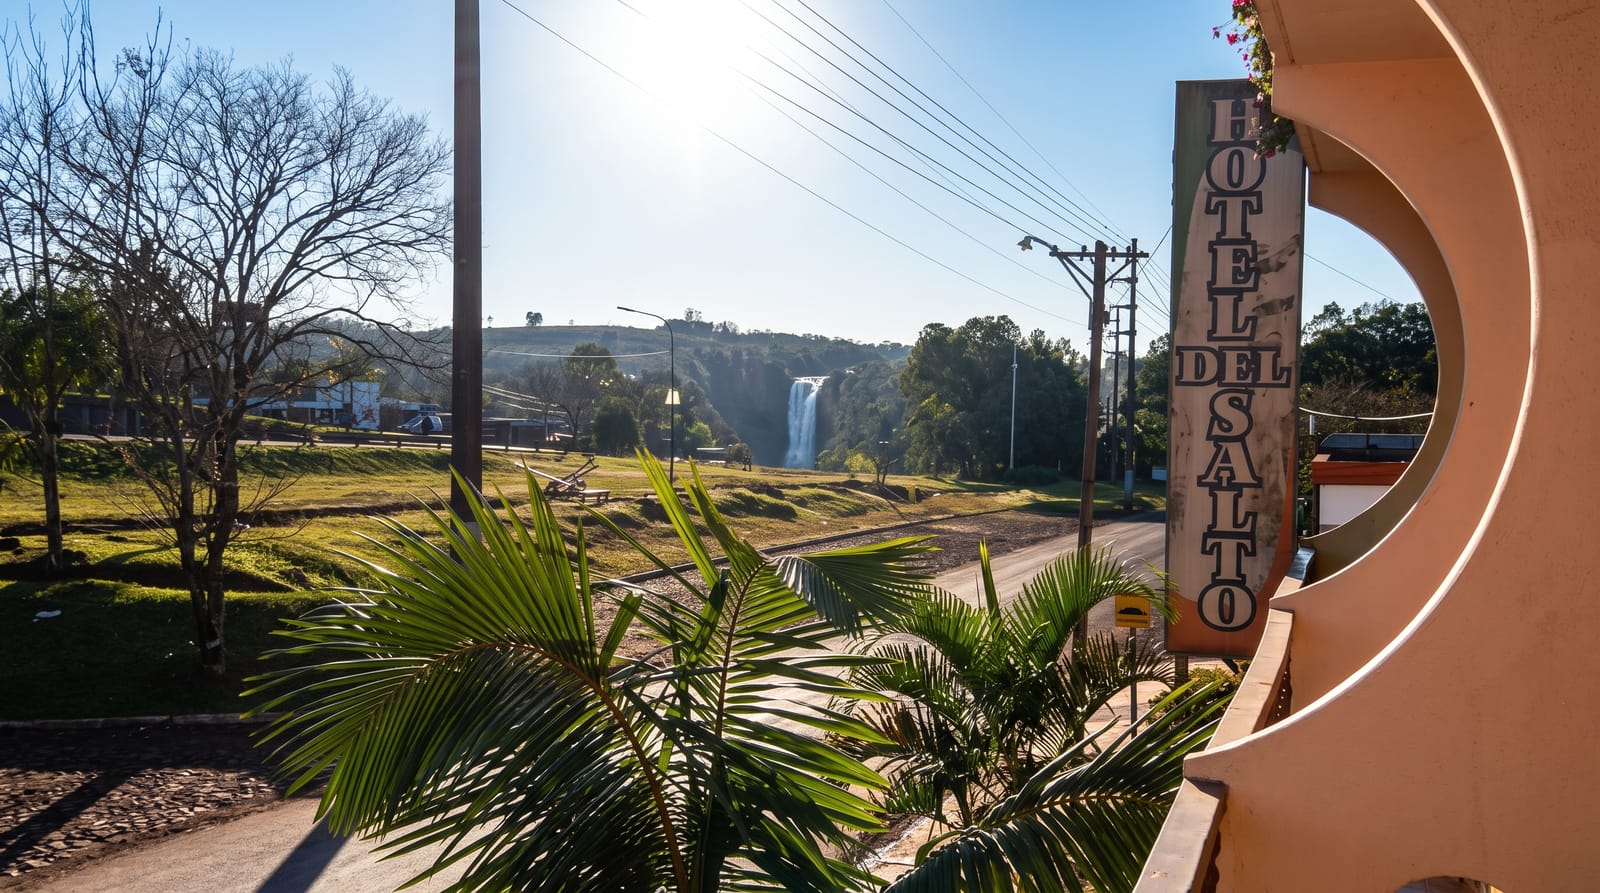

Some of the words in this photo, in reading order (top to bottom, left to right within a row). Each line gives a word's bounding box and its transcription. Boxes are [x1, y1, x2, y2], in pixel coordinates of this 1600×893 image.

[1205, 97, 1266, 341] HOTEL
[1175, 346, 1292, 388] DEL
[1197, 388, 1262, 632] SALTO
